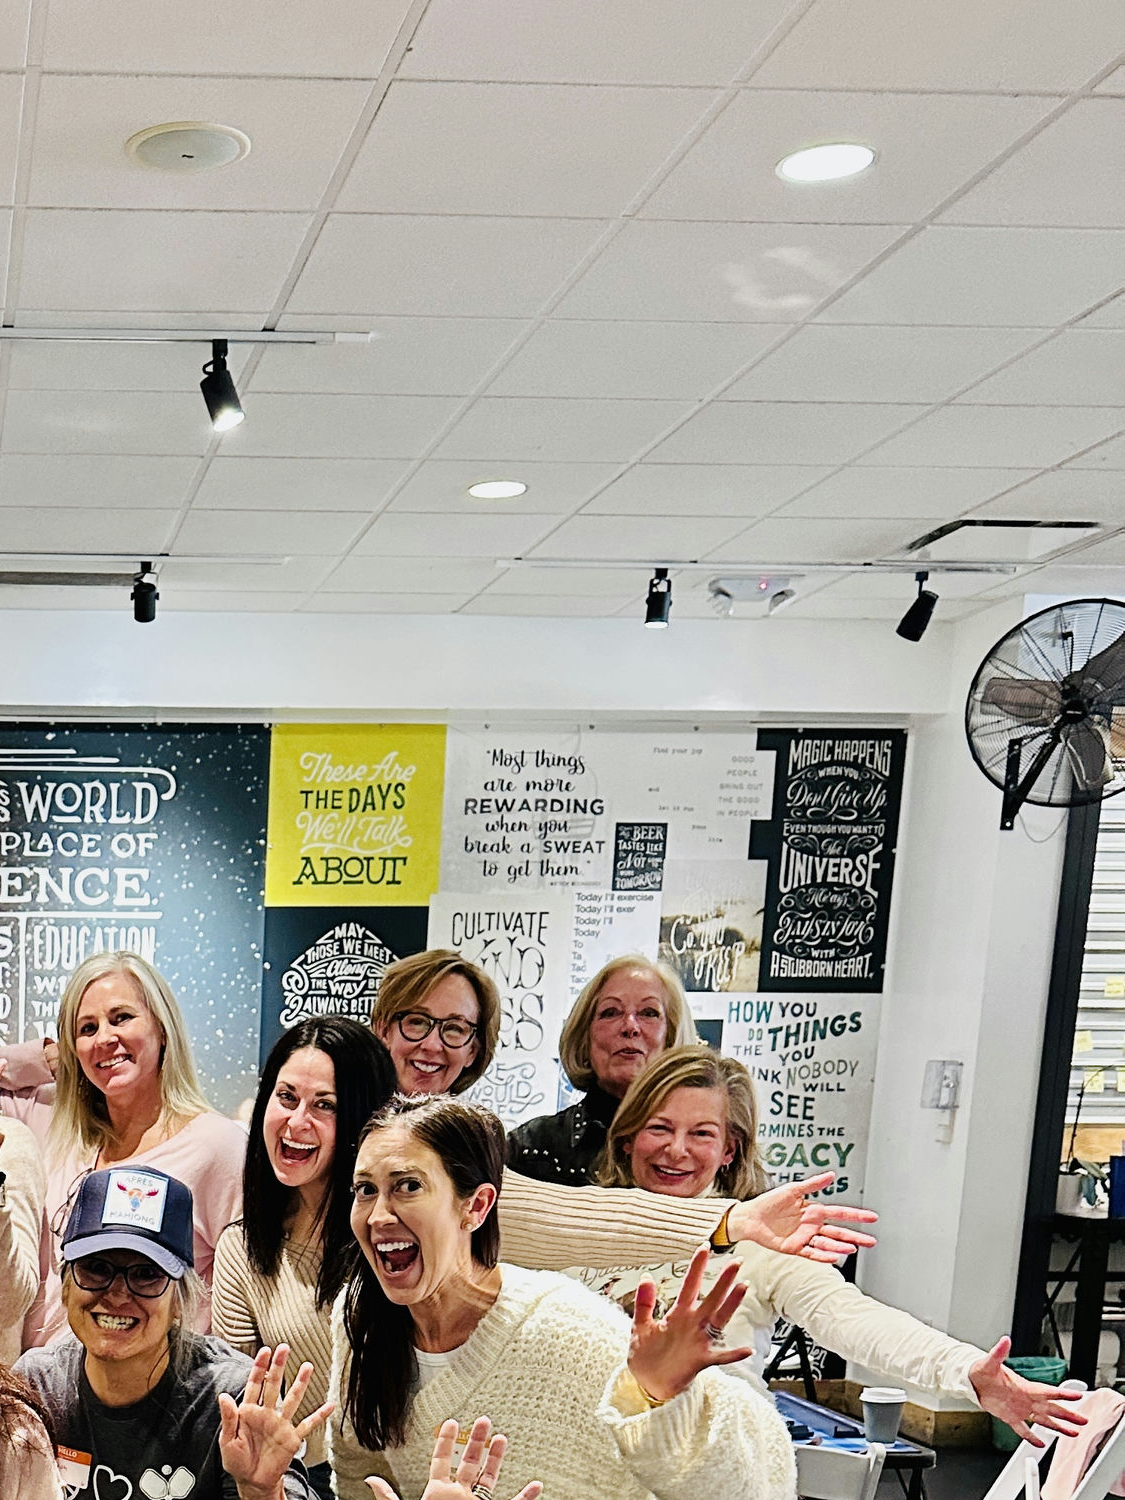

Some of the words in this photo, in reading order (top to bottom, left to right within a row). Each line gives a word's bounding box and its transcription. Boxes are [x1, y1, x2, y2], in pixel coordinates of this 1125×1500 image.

[300, 751, 368, 783] These
[369, 751, 417, 782] Are
[535, 748, 586, 775] things
[787, 739, 833, 776] MAGIC
[833, 740, 892, 777] HAPPENS
[726, 769, 758, 777] PEOPLE
[818, 766, 843, 778] WHEN
[843, 766, 859, 780] YOU
[483, 778, 516, 792] are
[525, 778, 576, 792] more
[16, 780, 159, 825] WORLD
[299, 789, 343, 810] THE
[348, 782, 406, 813] DAYS
[464, 798, 605, 815] REWARDING
[826, 781, 862, 816] Give
[728, 809, 759, 817] PEOPLE
[296, 811, 356, 845] We'll
[355, 814, 413, 849] Talk
[485, 814, 529, 833] when
[538, 819, 570, 840] you
[631, 825, 664, 841] BEER
[783, 822, 807, 836] EVEN
[807, 824, 837, 835] THOUGH
[838, 824, 851, 834] YOU
[852, 824, 873, 834] WANT
[873, 823, 885, 837] TO
[0, 831, 102, 857] PLACE
[110, 832, 159, 858] OF
[464, 835, 512, 854] break
[520, 842, 534, 854] a
[543, 840, 606, 853] SWEAT
[617, 840, 645, 851] TASTES
[645, 842, 664, 855] LIKE
[292, 856, 408, 885] ABOUT
[483, 859, 498, 877] to
[507, 859, 531, 883] get
[779, 841, 883, 898] UNIVERSE
[576, 893, 602, 901] Today
[604, 893, 614, 901] I'll
[617, 893, 654, 901] exercise
[575, 904, 602, 914] Today
[604, 905, 614, 913] I'll
[334, 922, 366, 940] MAY
[451, 911, 550, 947] CULTIVATE
[574, 916, 601, 926] Today
[603, 917, 613, 925] I'll
[574, 928, 600, 938] Today
[305, 941, 340, 965] THOSE
[342, 938, 363, 955] WE
[364, 942, 392, 963] MEET
[573, 940, 584, 948] To
[811, 947, 836, 958] WITH
[572, 951, 582, 960] Ta
[770, 950, 780, 977] A
[780, 954, 833, 977] STUBBORN
[326, 959, 369, 978] Along
[694, 941, 745, 991] KEEP
[310, 978, 328, 990] THE
[328, 980, 367, 999] WAY
[302, 996, 348, 1016] ALWAYS
[728, 1001, 774, 1023] HOW
[778, 1002, 818, 1018] YOU
[748, 1028, 763, 1041] DO
[768, 1011, 863, 1052] THINGS
[733, 1044, 763, 1056] THE
[778, 1045, 815, 1066] YOU
[751, 1066, 782, 1084] INK
[785, 1059, 860, 1090] NOBODY
[802, 1082, 846, 1093] WILL
[769, 1090, 816, 1121] SEE
[758, 1123, 815, 1138] RMINES
[817, 1126, 845, 1137] THE
[765, 1142, 855, 1169] GACY
[772, 1171, 805, 1183] HE
[110, 1210, 155, 1225] MAHJONG
[58, 1446, 78, 1458] HELLO
